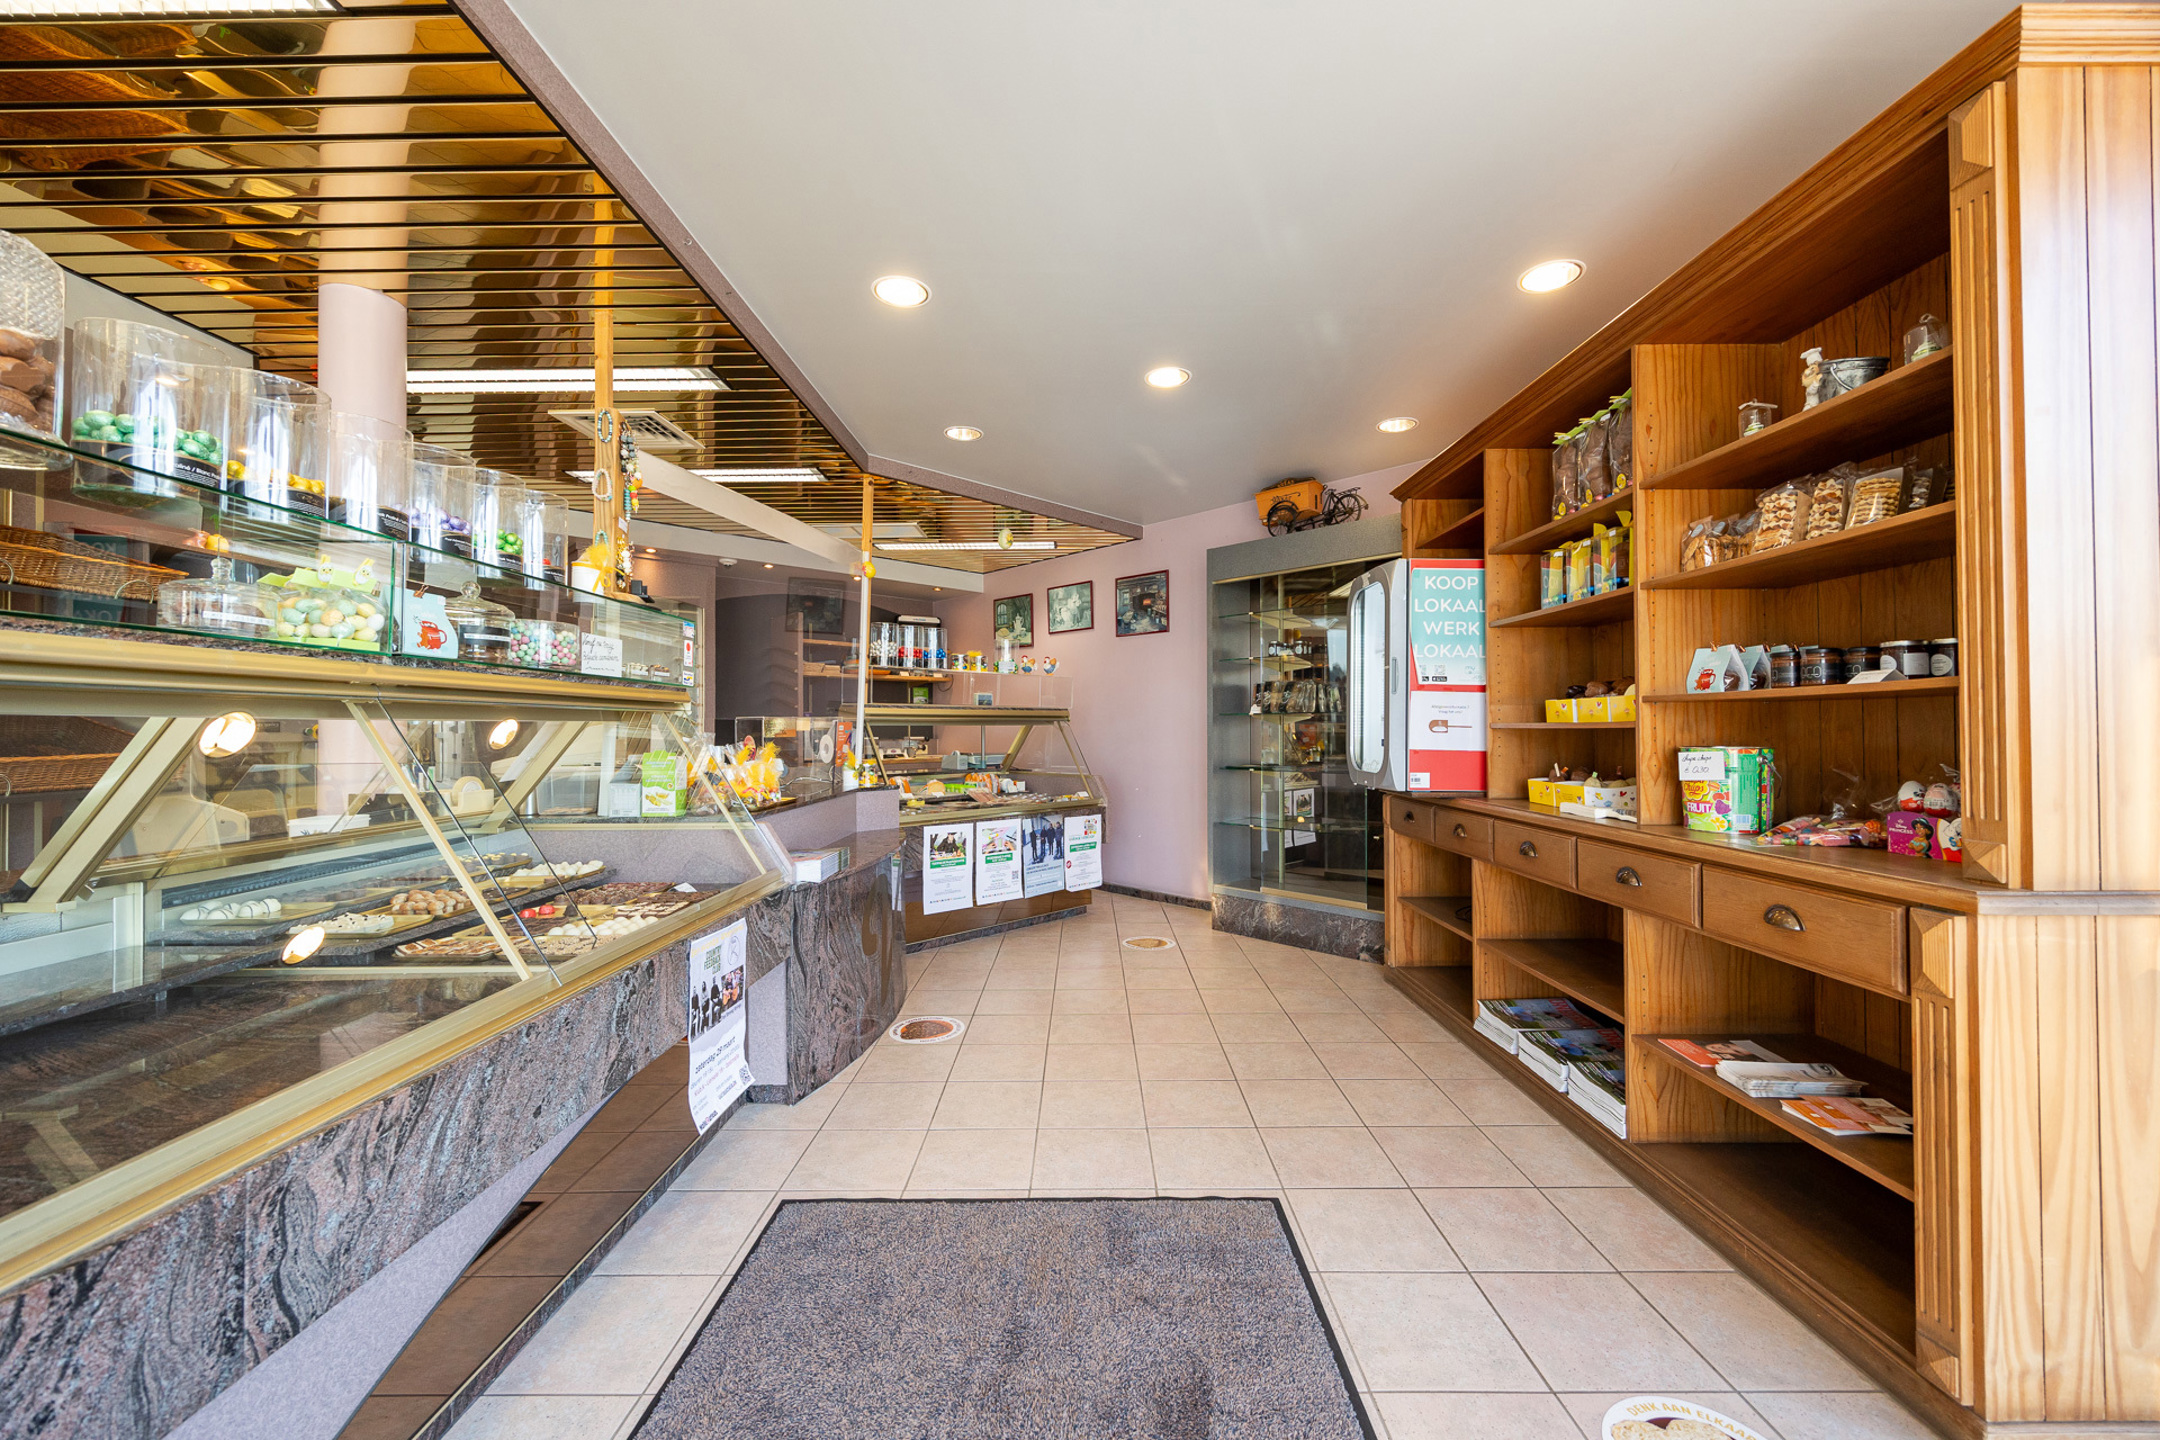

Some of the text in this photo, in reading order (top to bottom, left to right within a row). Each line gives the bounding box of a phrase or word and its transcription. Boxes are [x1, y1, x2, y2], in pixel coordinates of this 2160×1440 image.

[1425, 576, 1479, 590] KOOP
[1414, 598, 1486, 613] LOKAAL
[1423, 621, 1480, 636] WERK
[1415, 644, 1485, 658] LOKAAL
[1687, 802, 1712, 813] FRUIT
[1888, 827, 1914, 835] PRINCESS
[703, 954, 722, 970] FEEDBACK
[694, 1052, 717, 1074] zaterdag
[1626, 1402, 1661, 1416] DENK
[1661, 1403, 1692, 1415] AAN
